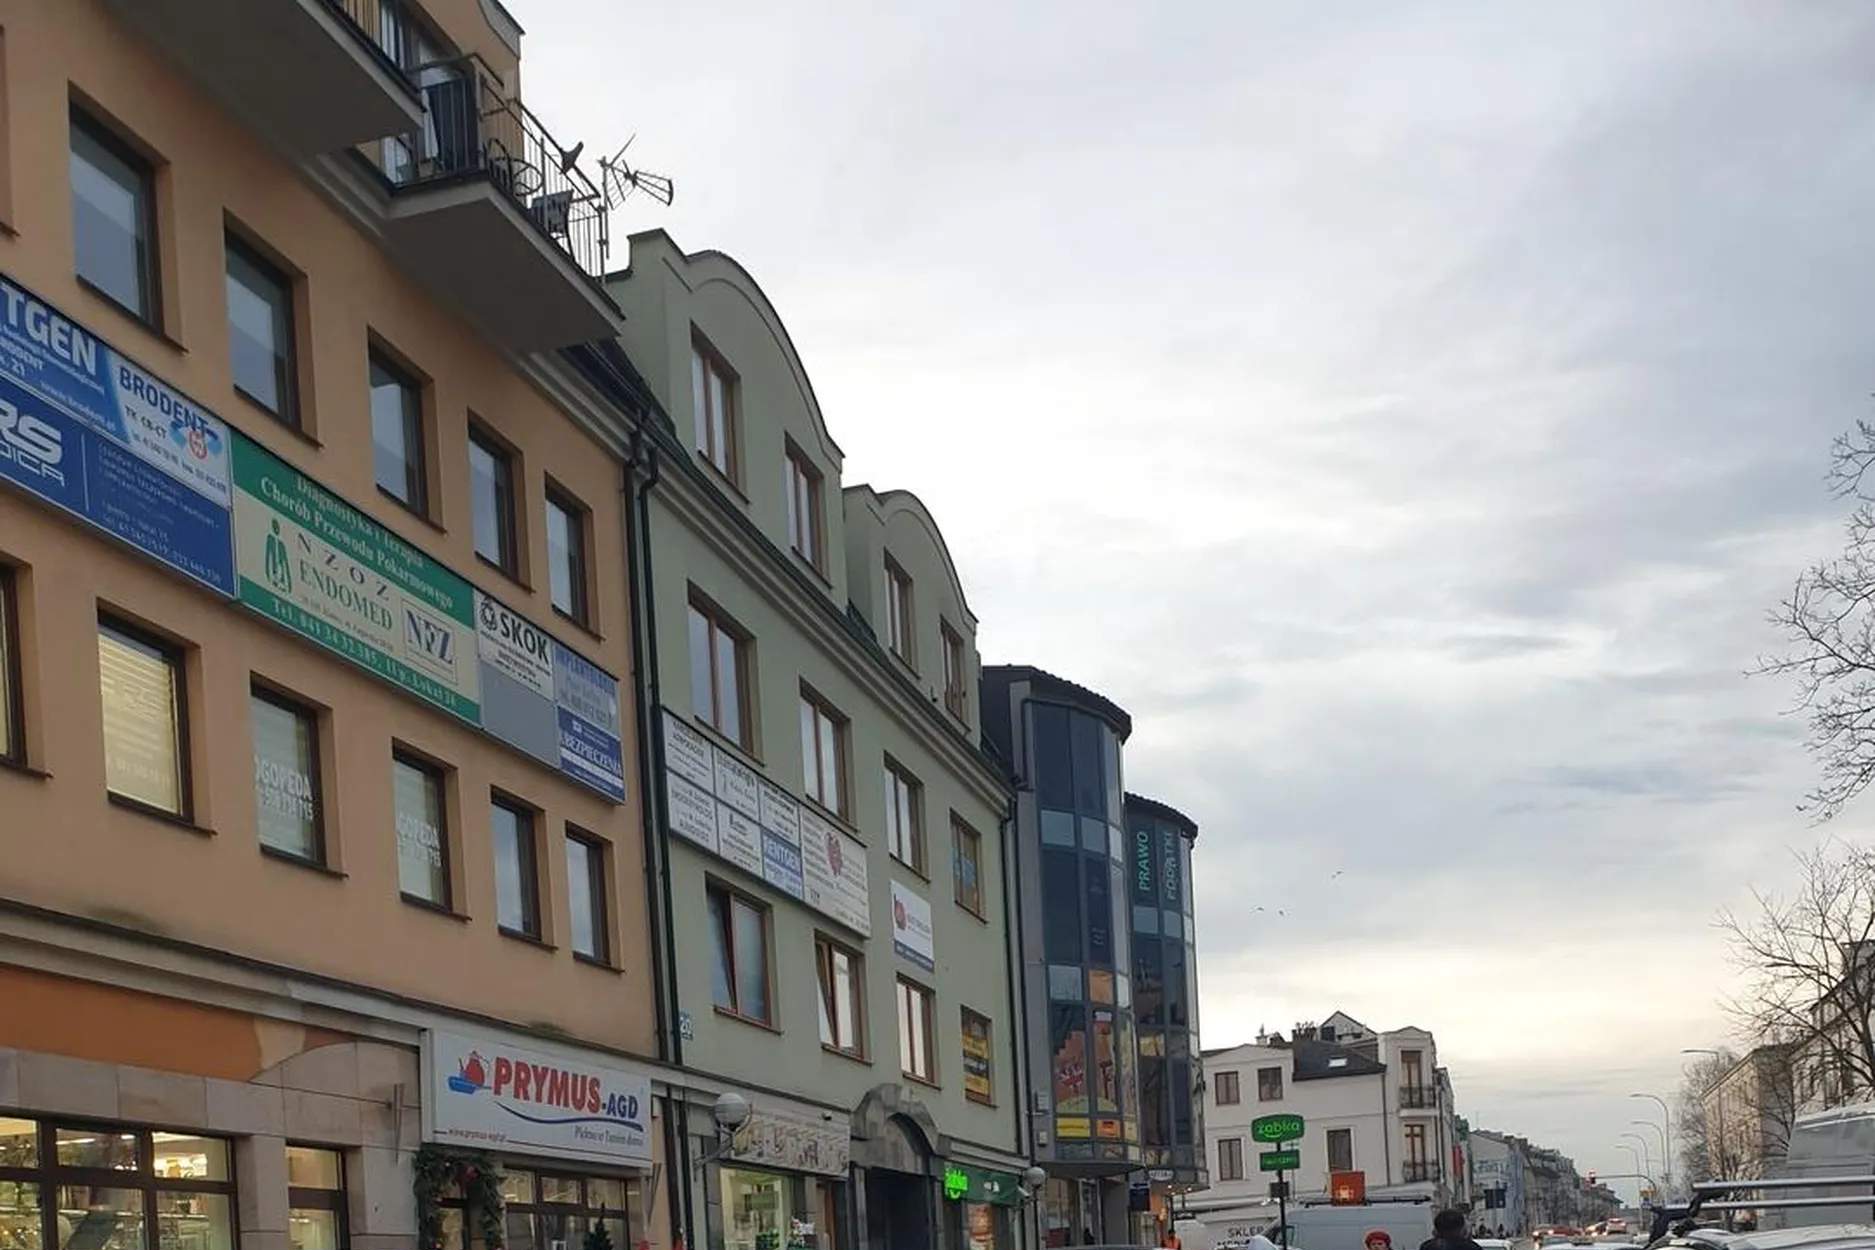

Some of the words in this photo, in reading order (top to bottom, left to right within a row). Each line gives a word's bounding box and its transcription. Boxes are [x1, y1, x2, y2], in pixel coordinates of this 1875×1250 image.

[119, 365, 210, 433] BRODENT
[260, 476, 311, 521] Chorób
[314, 504, 374, 562] Przewodu
[377, 550, 456, 610] Pokarmowego
[300, 560, 393, 632] ENDOMED
[500, 610, 549, 666] SKOK
[1136, 831, 1151, 891] PRAWO
